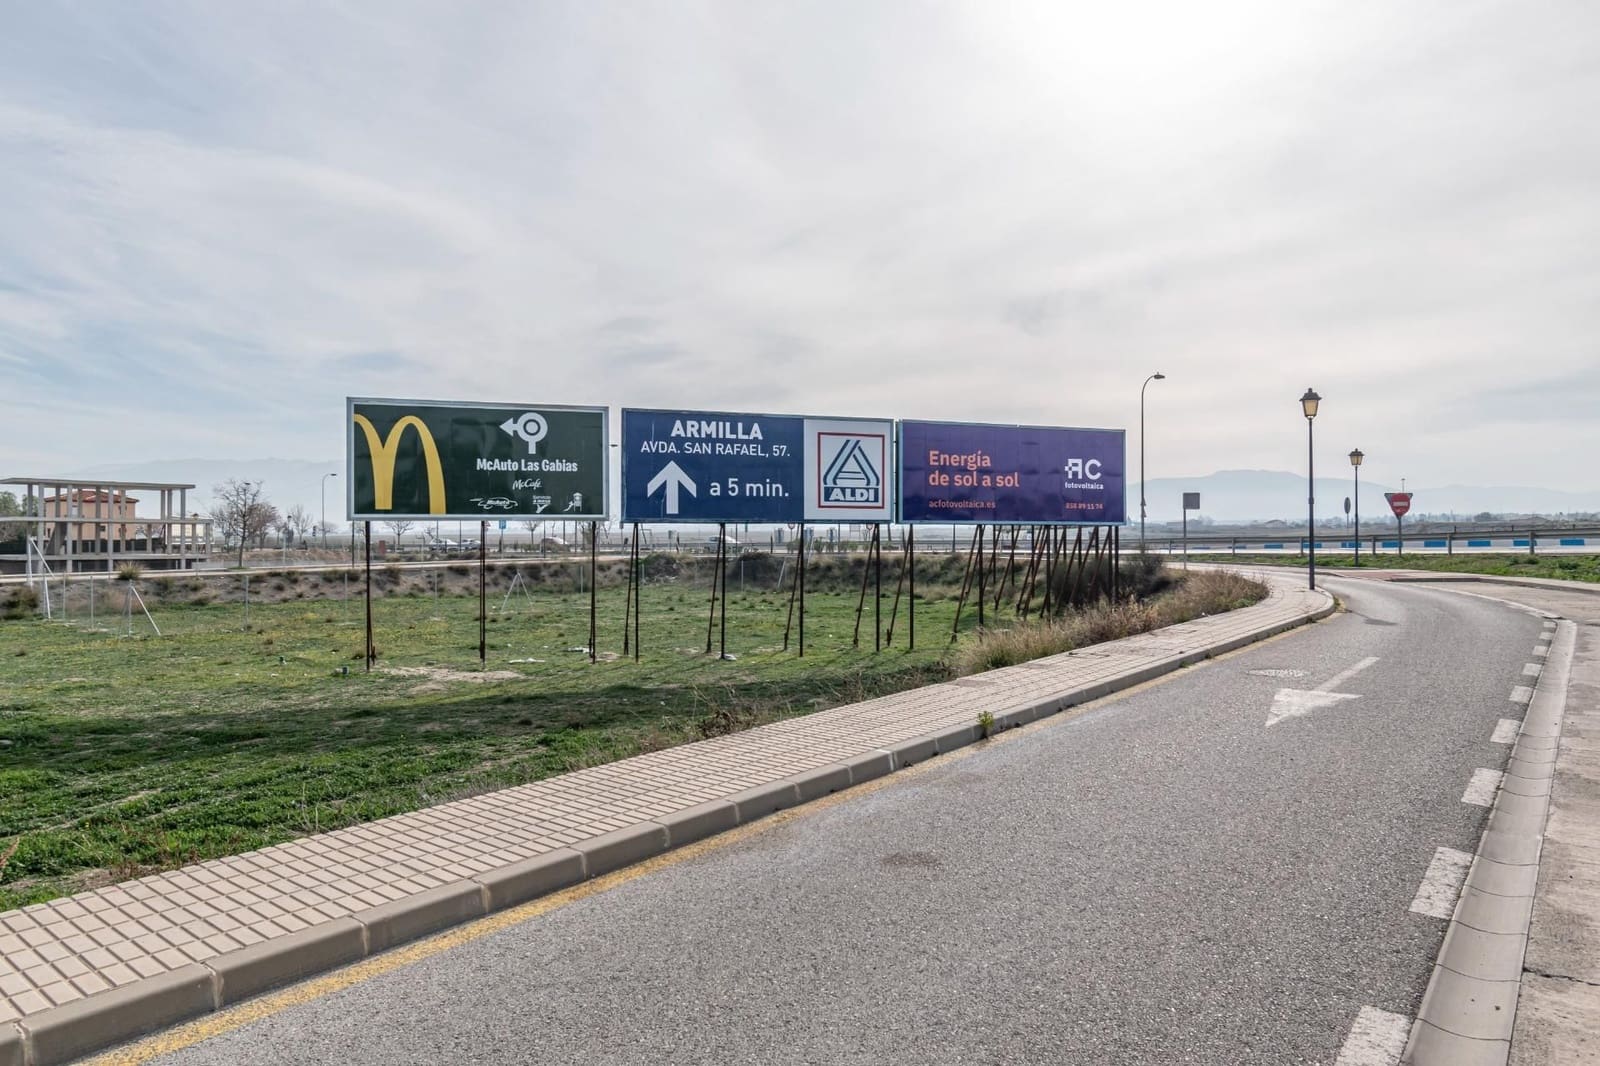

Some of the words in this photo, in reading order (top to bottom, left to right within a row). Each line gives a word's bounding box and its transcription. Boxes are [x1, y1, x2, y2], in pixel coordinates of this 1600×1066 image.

[670, 419, 763, 440] ARMILLA
[640, 441, 681, 454] AVDA.
[684, 443, 712, 455] SAN
[715, 443, 769, 458] RAFAEL,
[772, 445, 791, 457] 57.
[476, 458, 518, 471] McAuto
[521, 459, 540, 472] Las
[541, 459, 578, 472] Gabias
[929, 450, 991, 471] Energía
[1064, 458, 1102, 480] AC
[710, 481, 721, 496] a
[728, 478, 739, 496] 5
[745, 479, 790, 497] min.
[928, 470, 949, 486] de
[954, 471, 978, 487] sol
[982, 474, 991, 487] a
[996, 471, 1019, 488] sol
[1064, 481, 1104, 490] fotovoltaica
[828, 487, 875, 502] ALDI
[928, 499, 996, 509] acfotovoltaica.es
